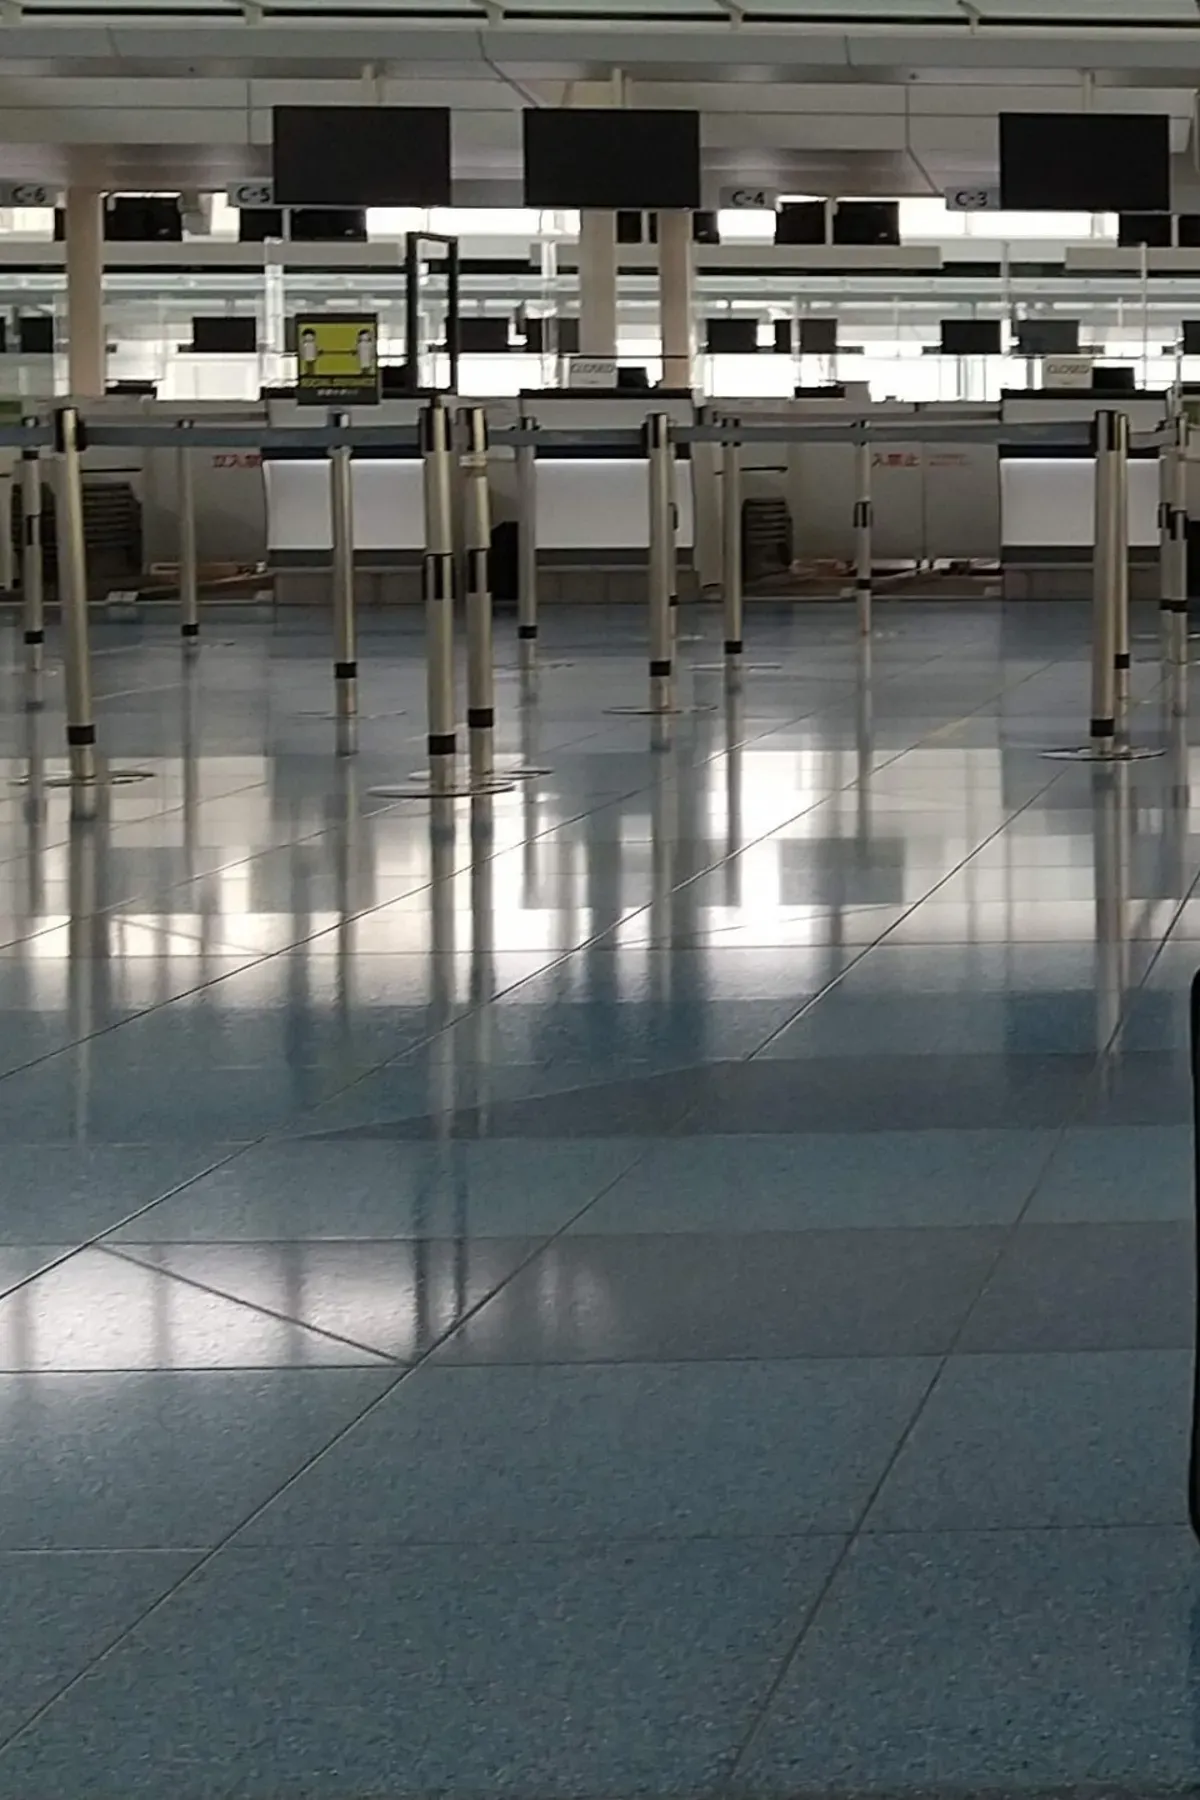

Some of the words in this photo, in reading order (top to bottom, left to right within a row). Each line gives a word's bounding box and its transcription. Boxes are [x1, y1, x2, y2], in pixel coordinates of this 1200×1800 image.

[11, 186, 46, 203] C-6
[236, 186, 271, 203] C-5
[731, 190, 765, 206] C-4
[955, 191, 988, 207] C-3
[213, 454, 262, 468] 立入禁
[871, 453, 920, 467] 入禁止
